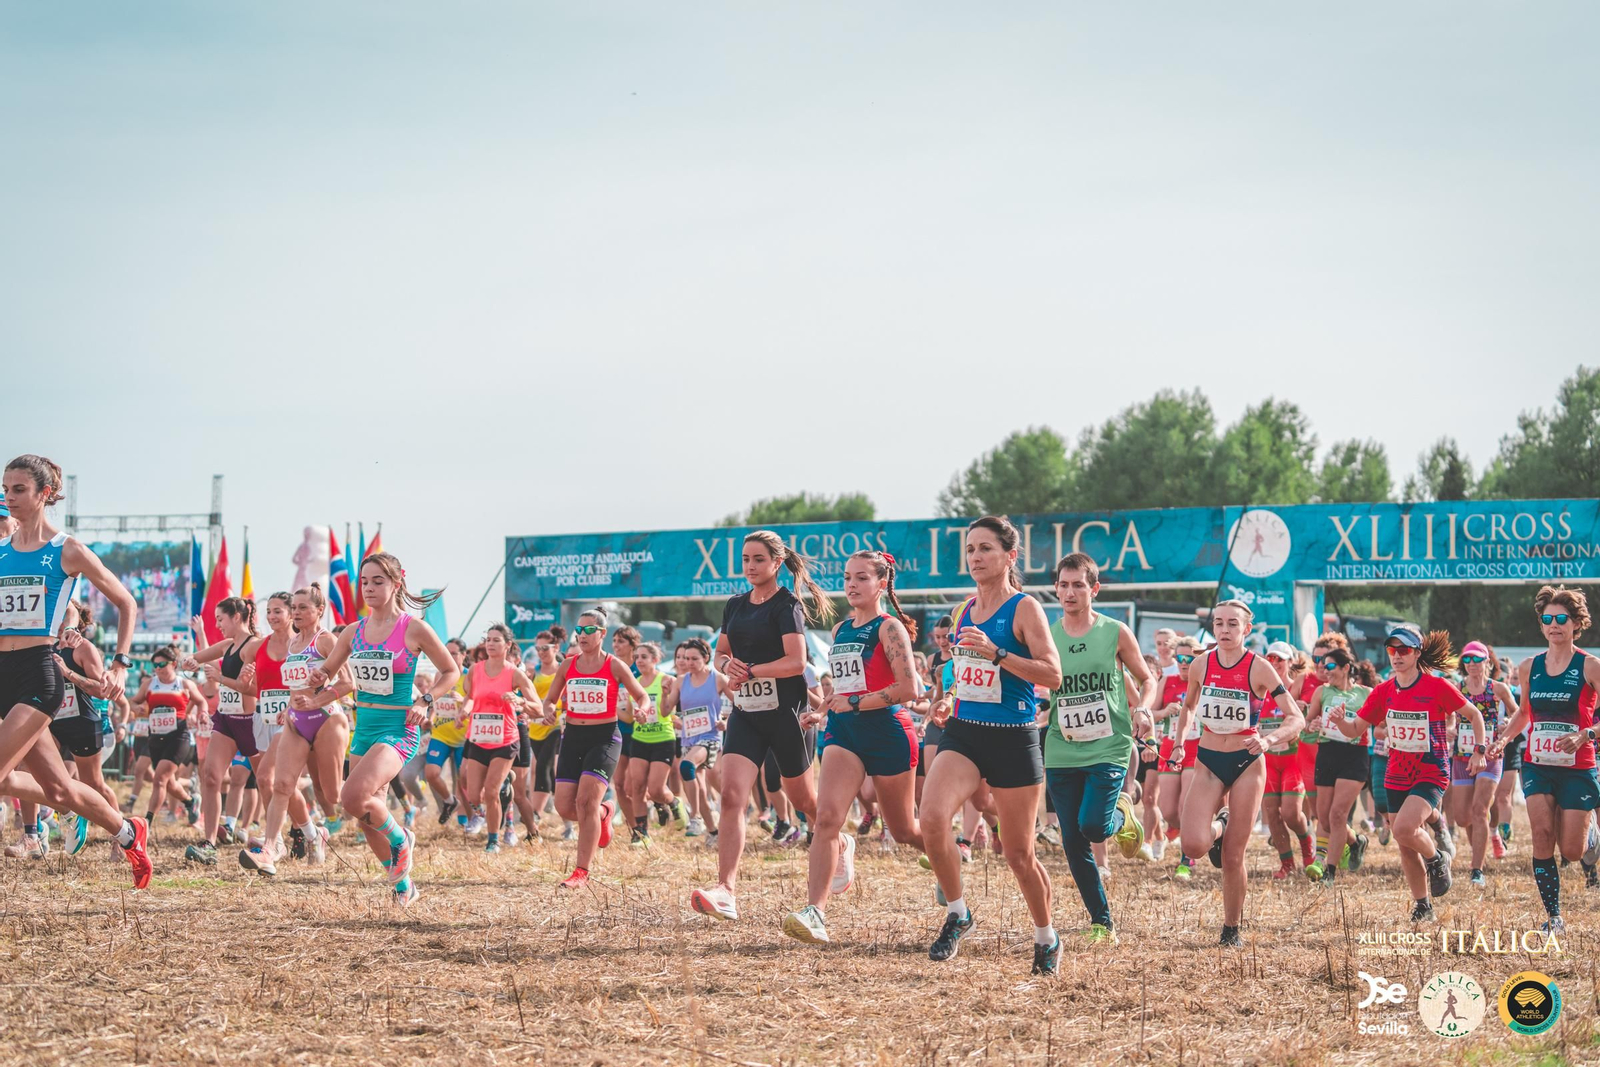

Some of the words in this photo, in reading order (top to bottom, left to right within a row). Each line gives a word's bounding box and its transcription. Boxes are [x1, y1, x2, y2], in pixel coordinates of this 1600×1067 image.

[1463, 512, 1572, 541] CROSS
[801, 531, 888, 559] CROSS
[1327, 513, 1460, 561] XLIII
[929, 519, 1153, 576] ITLICA
[514, 554, 580, 567] CAMPEONATO
[581, 554, 594, 564] DE
[595, 550, 654, 563] ANDALUCÍA
[536, 566, 548, 577] DE
[550, 565, 584, 576] CAMPO
[585, 565, 595, 574] A
[1326, 563, 1451, 579] INTERNATIONAL
[1455, 563, 1504, 577] CROSS
[1508, 562, 1586, 577] COUNTRY
[556, 575, 576, 586] POR
[577, 575, 611, 585] CLUBES
[284, 667, 307, 681] 1423
[354, 665, 390, 681] 1329
[1051, 672, 1113, 696] ARISCAL
[570, 691, 604, 703] 1168
[1530, 691, 1572, 699] Vanessa
[263, 701, 287, 714] 150
[1202, 703, 1246, 721] 1146
[151, 717, 175, 727] 1369
[684, 716, 709, 730] 1293
[1063, 708, 1107, 729] 1146
[474, 725, 502, 736] 1440
[1391, 725, 1427, 741] 1375
